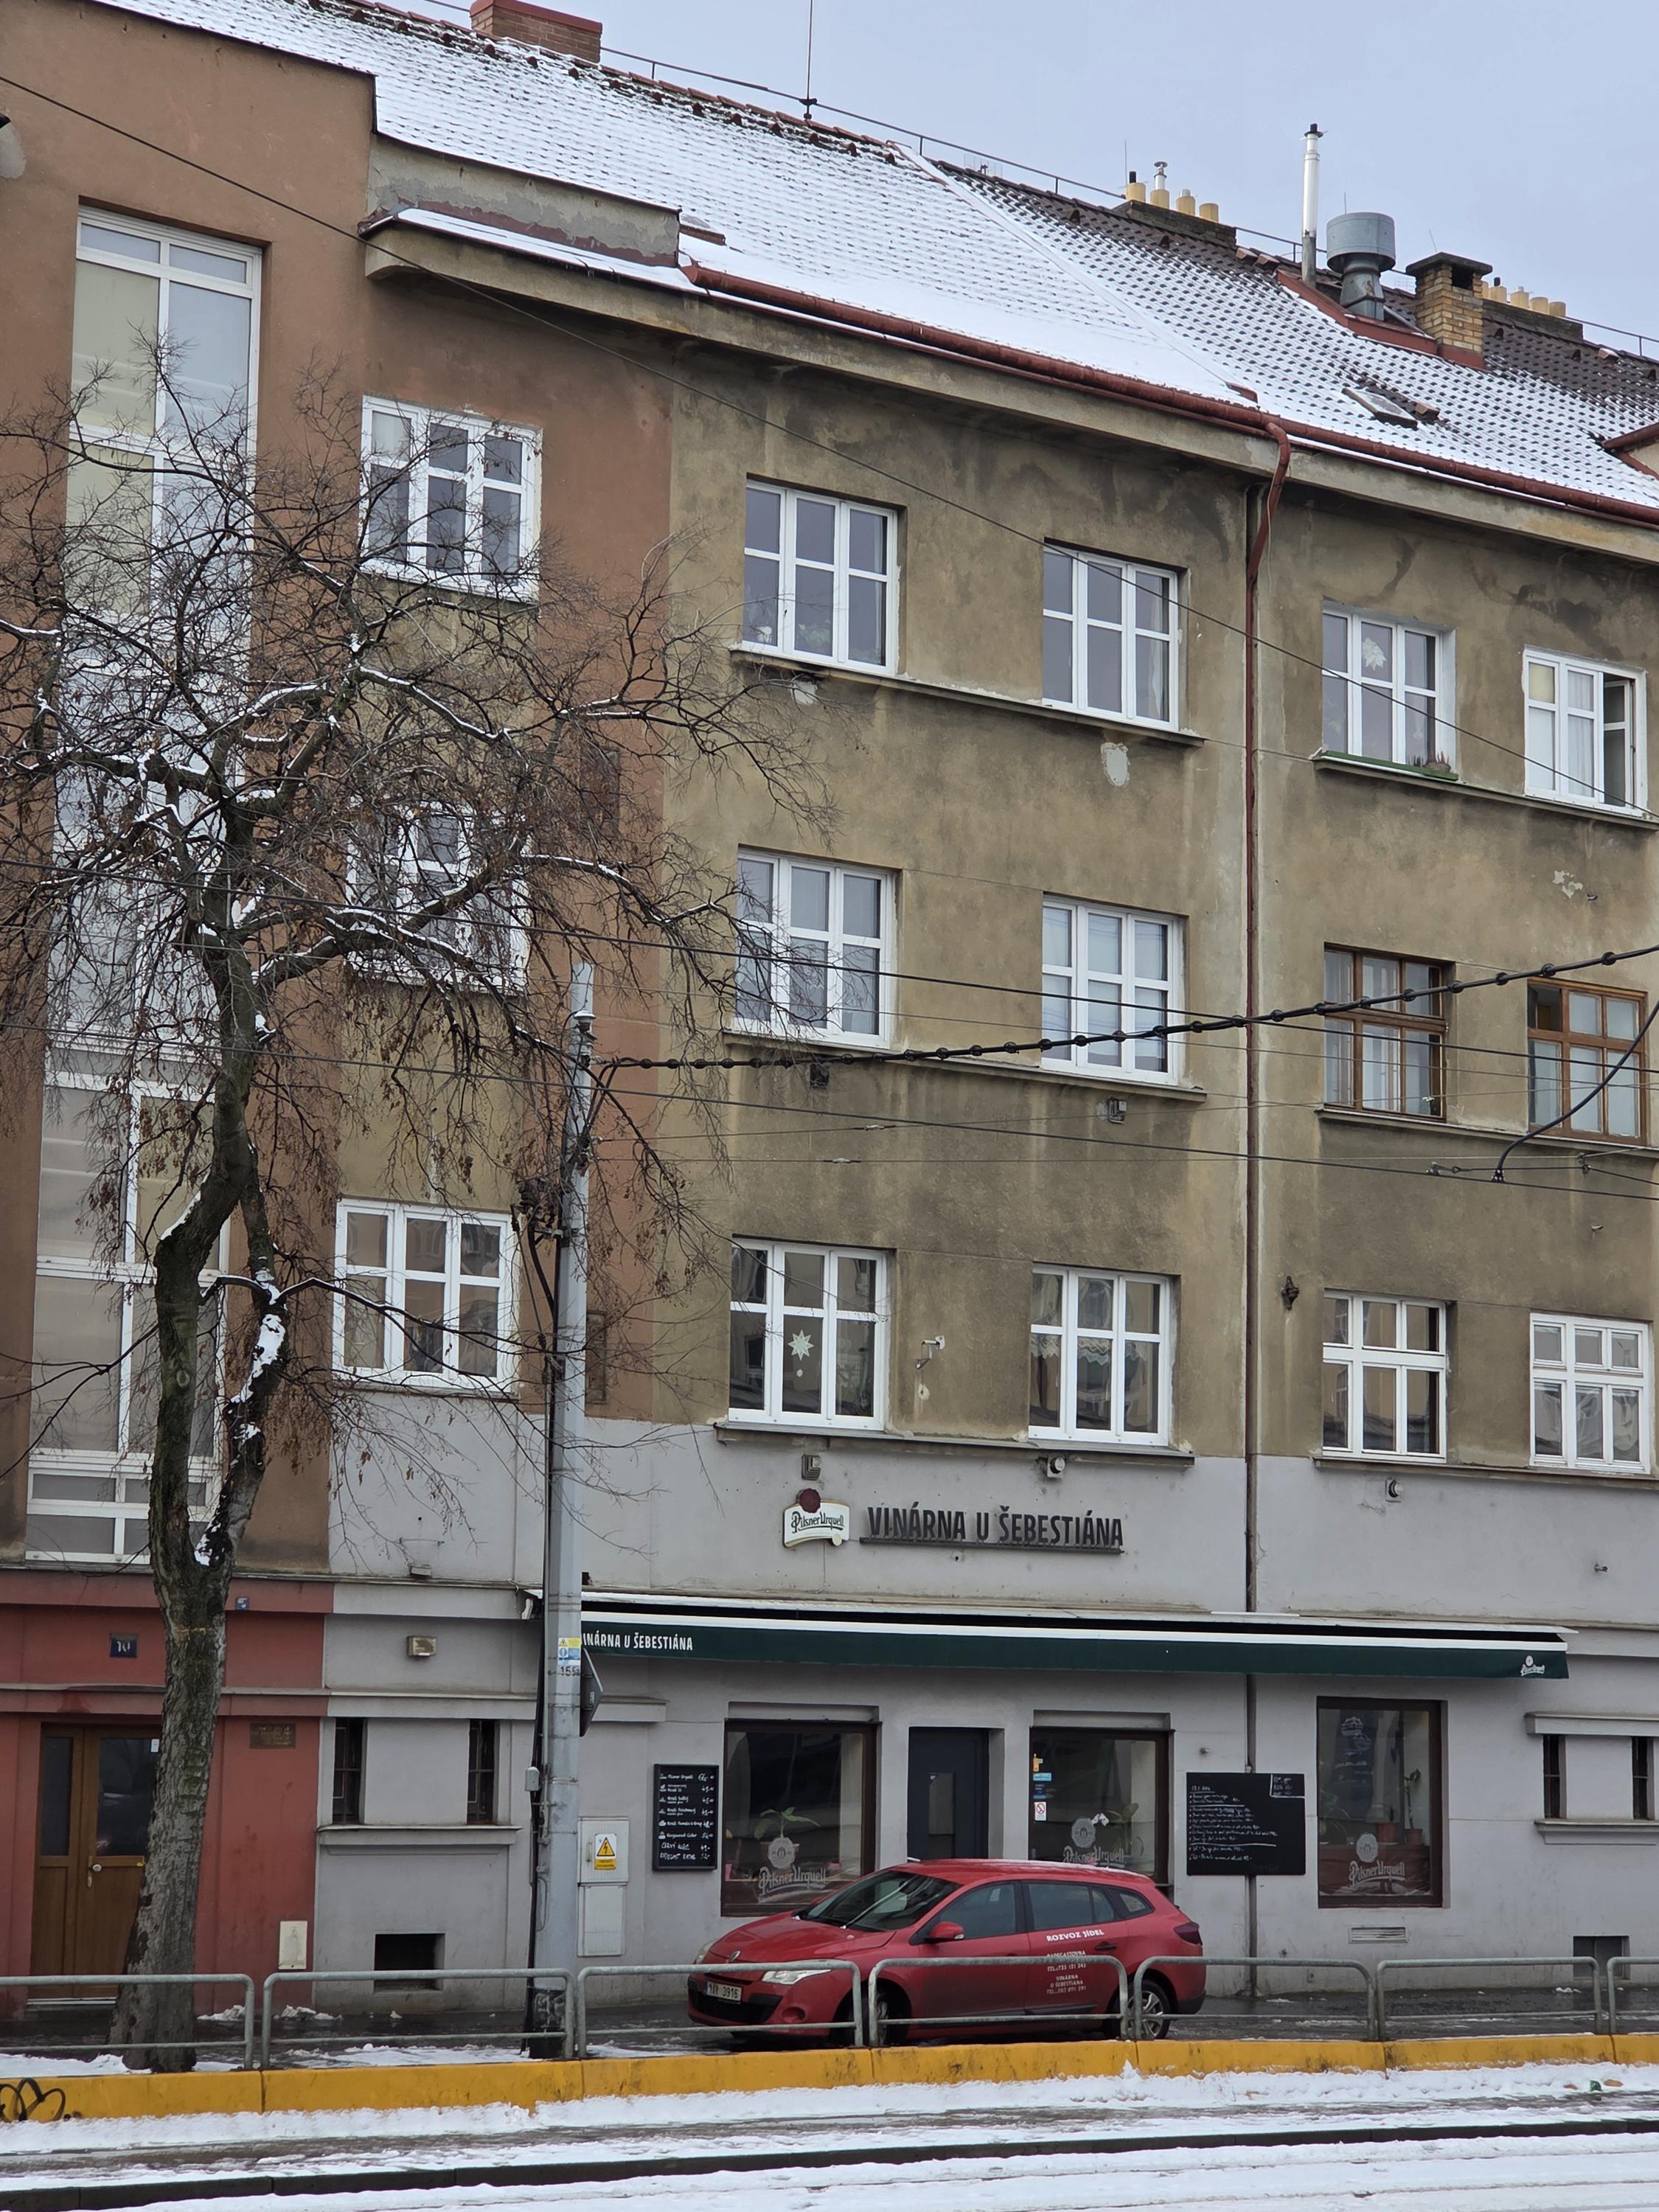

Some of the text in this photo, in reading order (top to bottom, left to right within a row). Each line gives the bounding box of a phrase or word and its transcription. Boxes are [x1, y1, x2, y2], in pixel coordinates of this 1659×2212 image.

[790, 1510, 845, 1534] Pilsner Urquell
[868, 1501, 1124, 1548] VINÁRNA U ŠEBESTIÁNA
[582, 1630, 693, 1652] INÁRNA U ŠEBESTIÁNA
[1063, 1845, 1124, 1868] Pilsner Urquell
[758, 1865, 827, 1896] Pilsner Urquell
[1349, 1859, 1405, 1888] Pilsner Urquell
[1046, 1929, 1105, 1942] ROZVOZ JÍDEL
